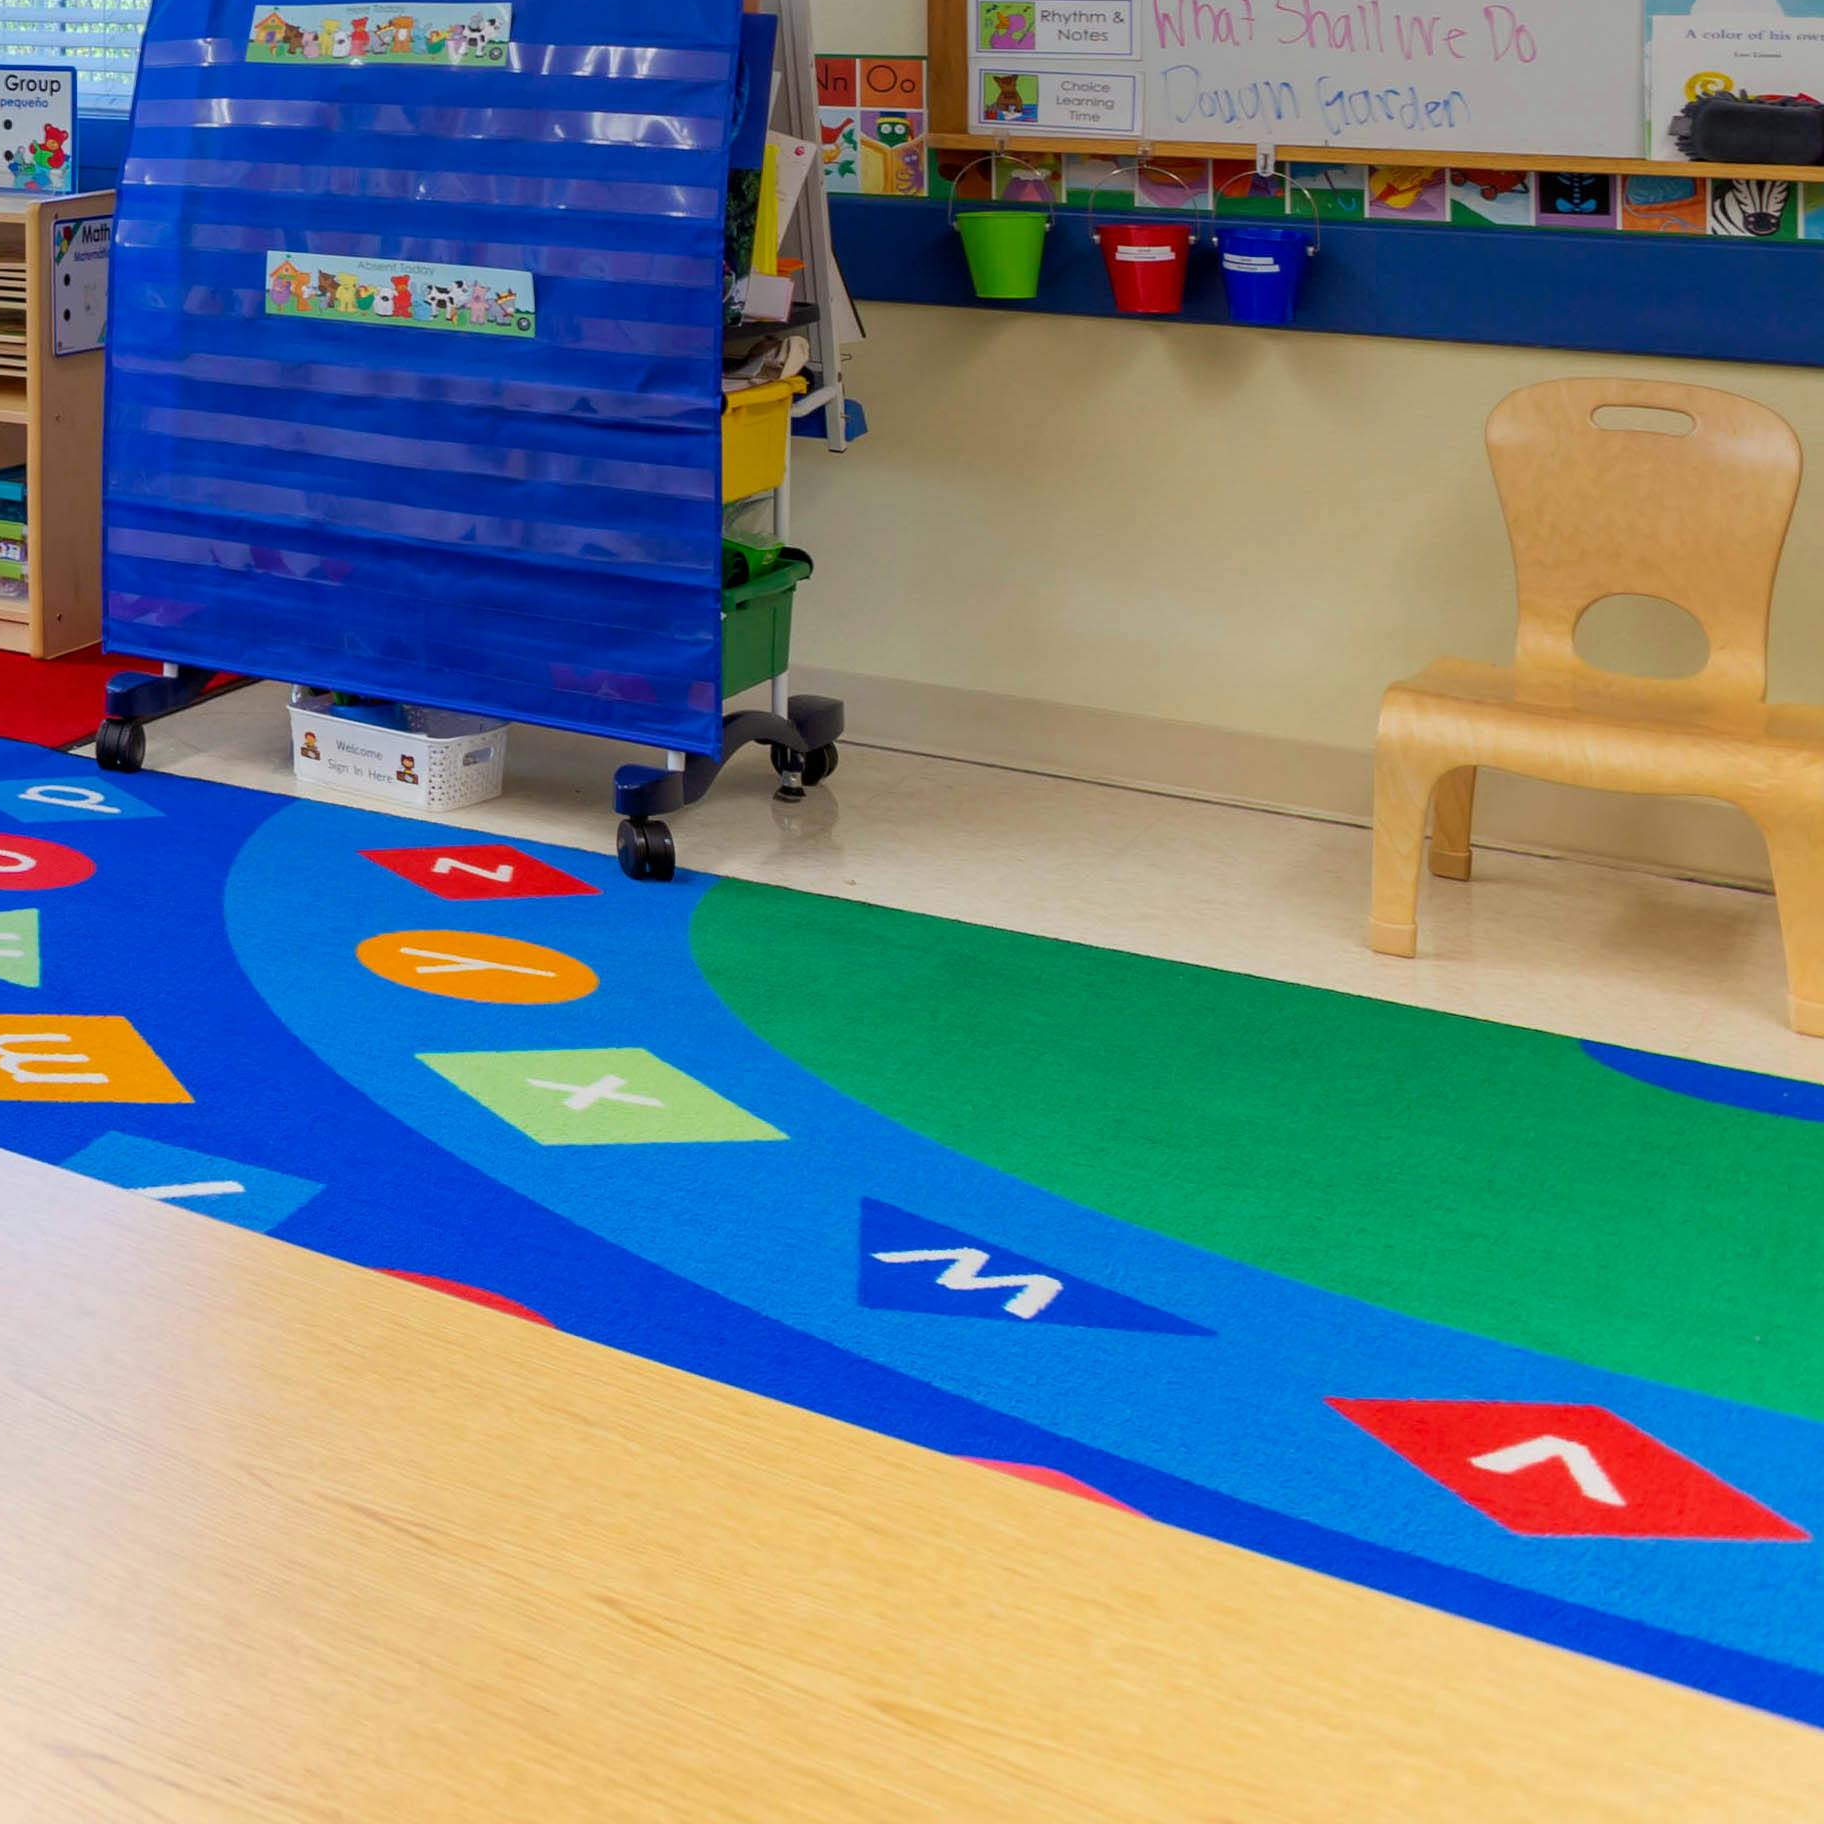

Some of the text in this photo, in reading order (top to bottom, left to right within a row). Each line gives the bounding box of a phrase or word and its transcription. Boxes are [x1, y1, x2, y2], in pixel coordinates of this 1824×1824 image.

[1039, 9, 1125, 25] Rhythm &
[1056, 28, 1110, 43] Notes
[1483, 4, 1538, 64] Do
[1685, 28, 1792, 42] A color of his
[4, 74, 62, 97] Group
[865, 63, 917, 94] Oo
[1060, 80, 1111, 94] Choice
[0, 95, 49, 109] pequeño
[1055, 96, 1116, 111] Learning
[1316, 75, 1473, 136] Garden
[1069, 109, 1101, 123] Time
[80, 223, 111, 244] Math
[357, 260, 435, 276] Absent Today
[335, 738, 384, 762] Welcome
[327, 758, 395, 784] Sign In Here
[398, 946, 557, 979] y
[525, 1073, 665, 1112] x
